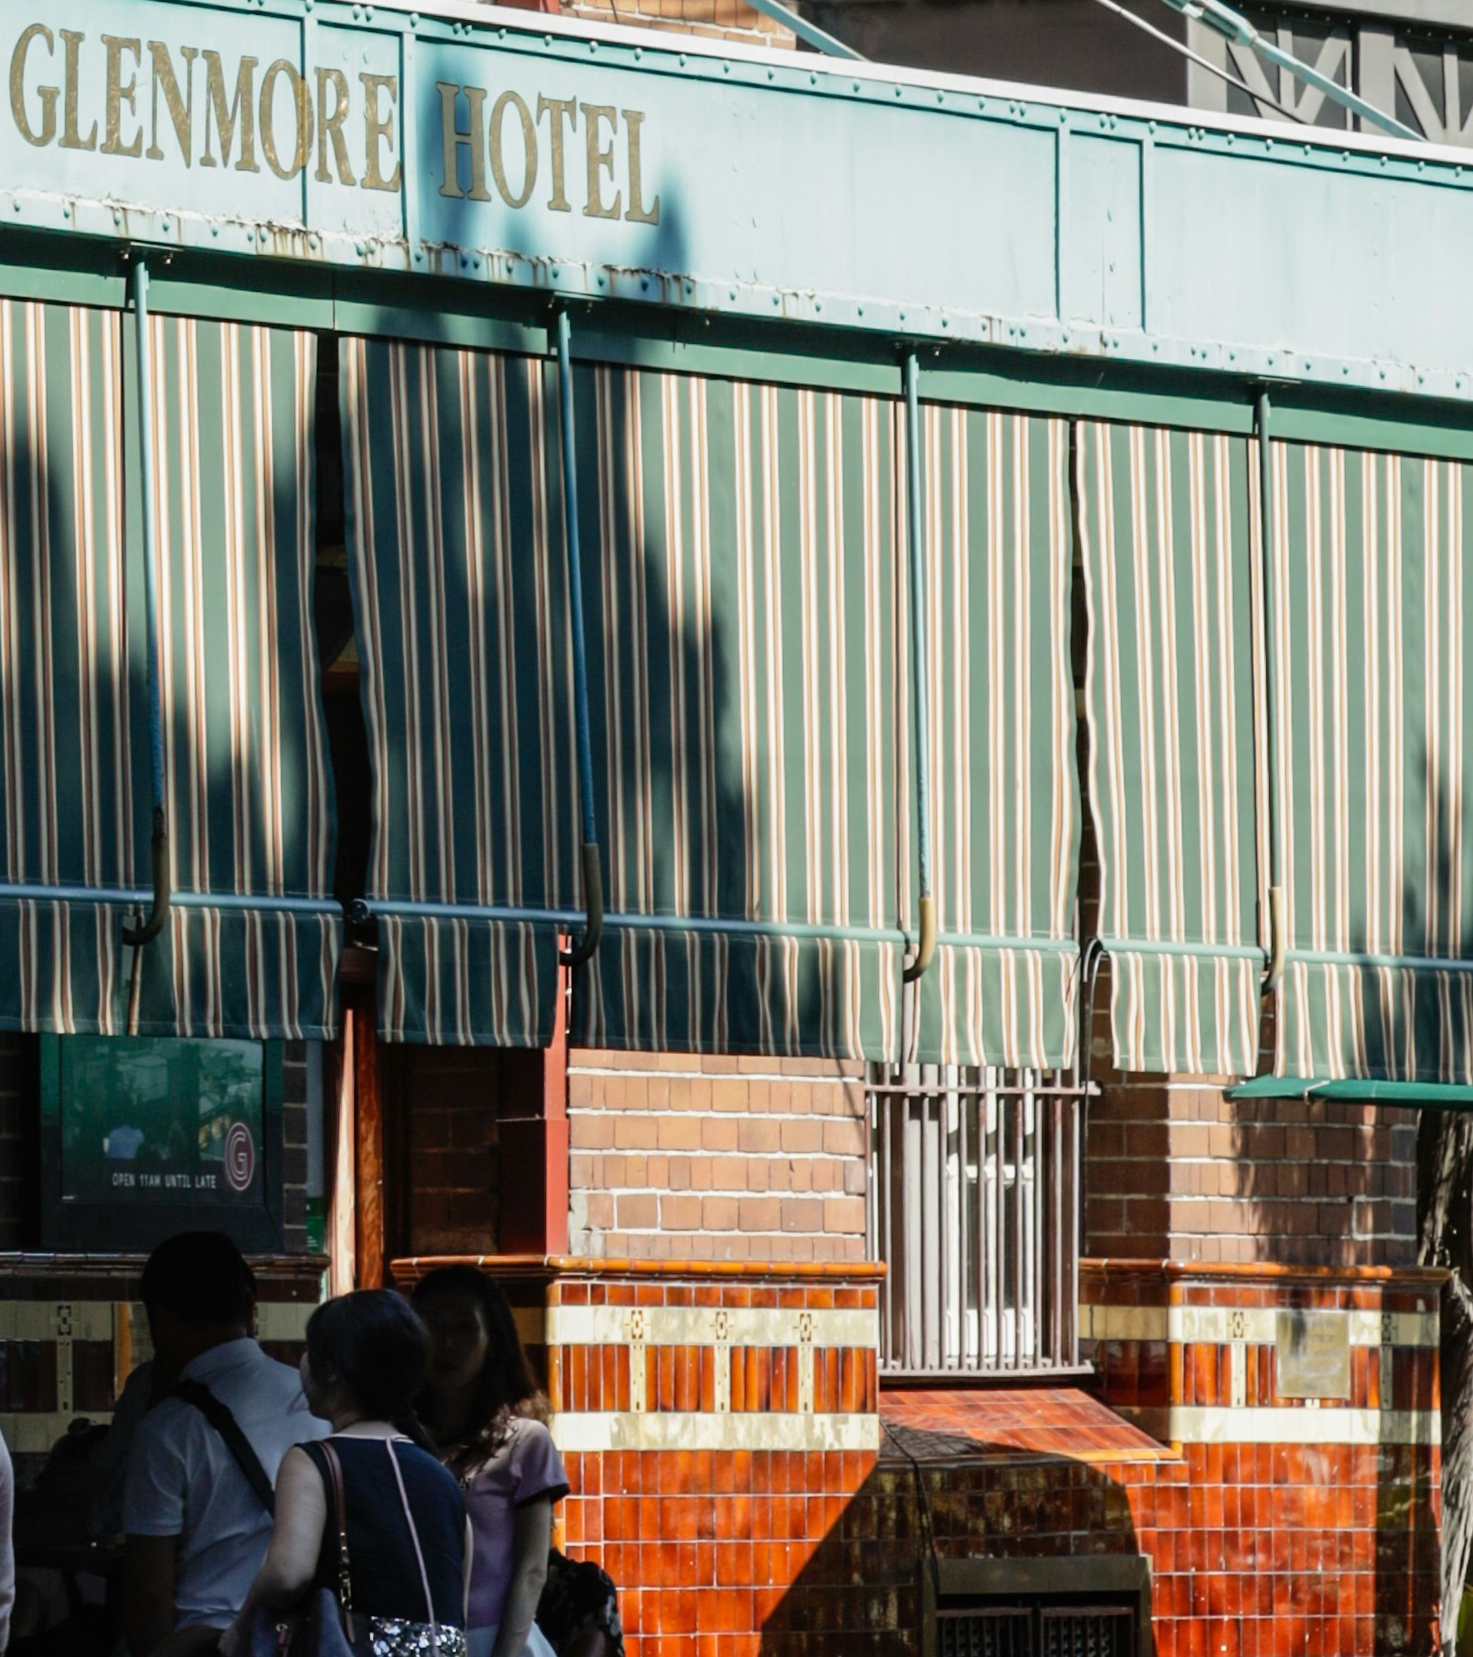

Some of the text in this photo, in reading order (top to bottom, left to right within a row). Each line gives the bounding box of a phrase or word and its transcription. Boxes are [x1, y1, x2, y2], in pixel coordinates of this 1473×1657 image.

[9, 22, 660, 226] GLENMORE HOTEL
[112, 1172, 217, 1189] OPEN 11AM UNTIL LATE
